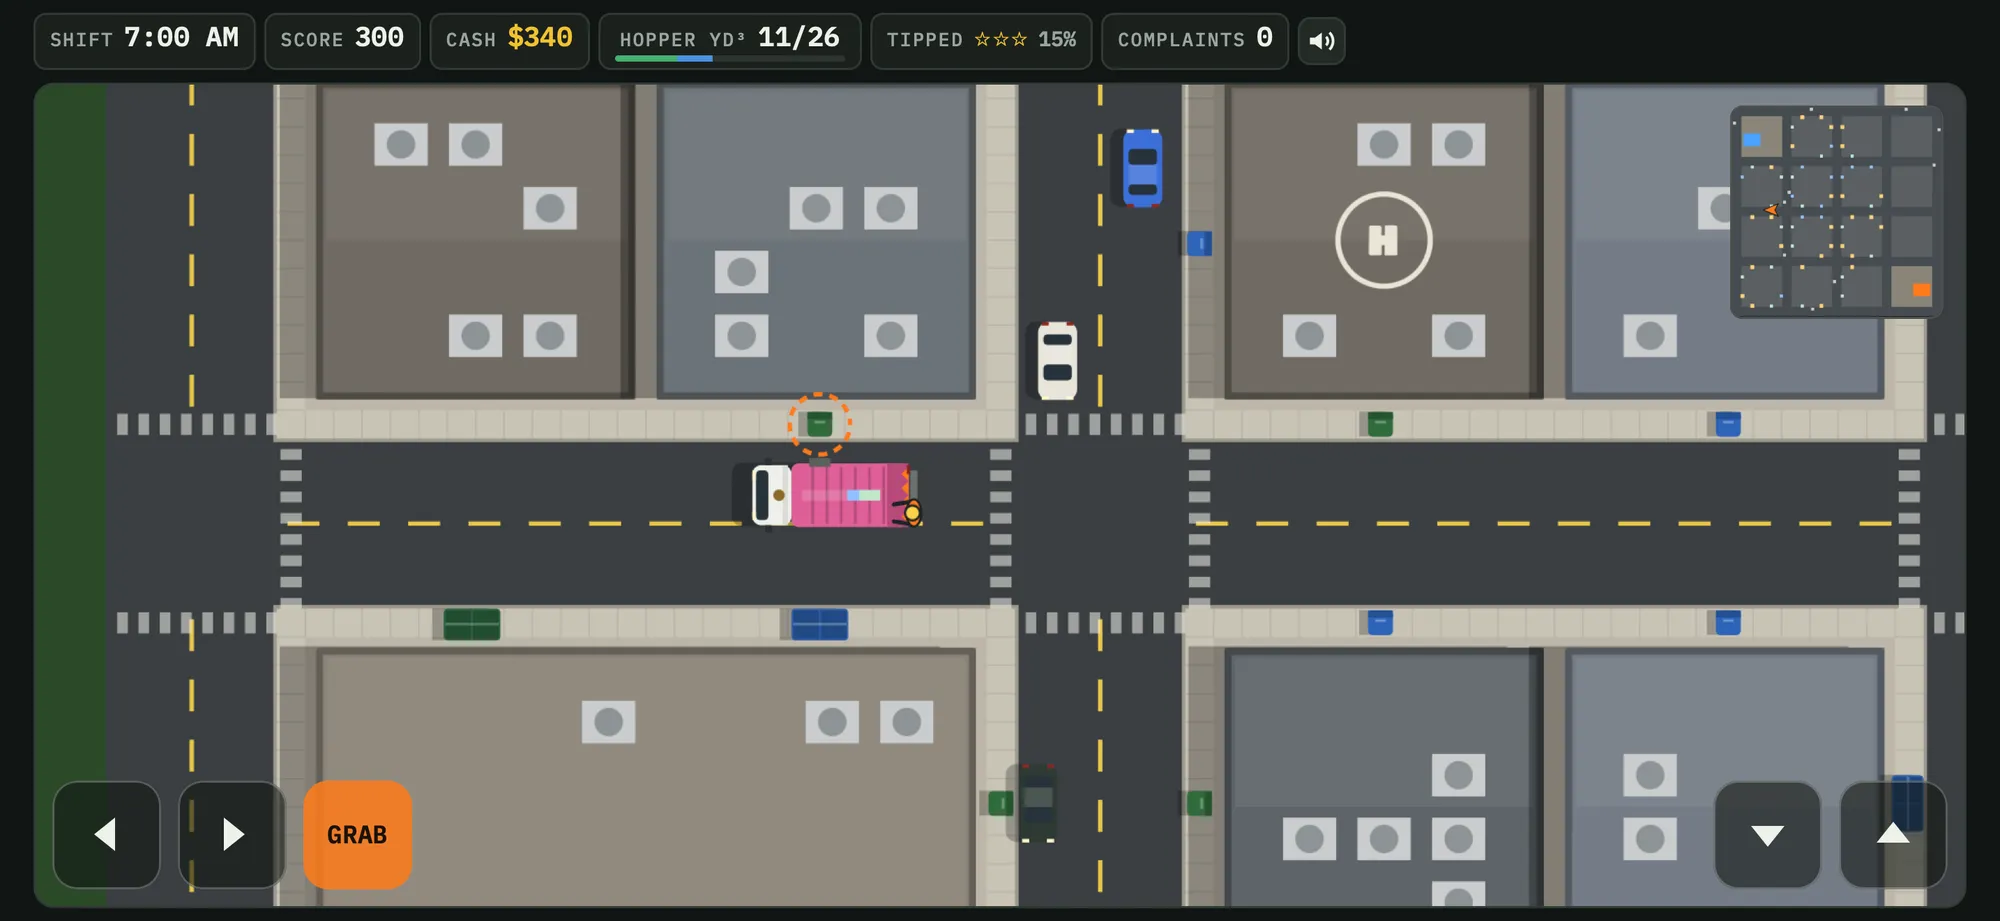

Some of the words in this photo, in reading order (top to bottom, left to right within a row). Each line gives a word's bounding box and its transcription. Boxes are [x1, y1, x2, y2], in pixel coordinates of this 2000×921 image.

[51, 32, 112, 47] SHIFT
[124, 26, 190, 48] 7:00
[205, 26, 239, 47] AM
[281, 32, 342, 47] SCORE
[355, 26, 404, 48] 300
[446, 32, 495, 47] CASH
[508, 23, 573, 51] $340
[620, 32, 696, 47] HOPPER
[758, 24, 840, 51] 11/26
[886, 32, 962, 47] TIPPED
[1039, 31, 1077, 48] 15%
[1118, 32, 1245, 48] COMPLAINTS
[1256, 25, 1273, 48] 0
[1368, 224, 1398, 256] H
[327, 824, 387, 844] GRAB
